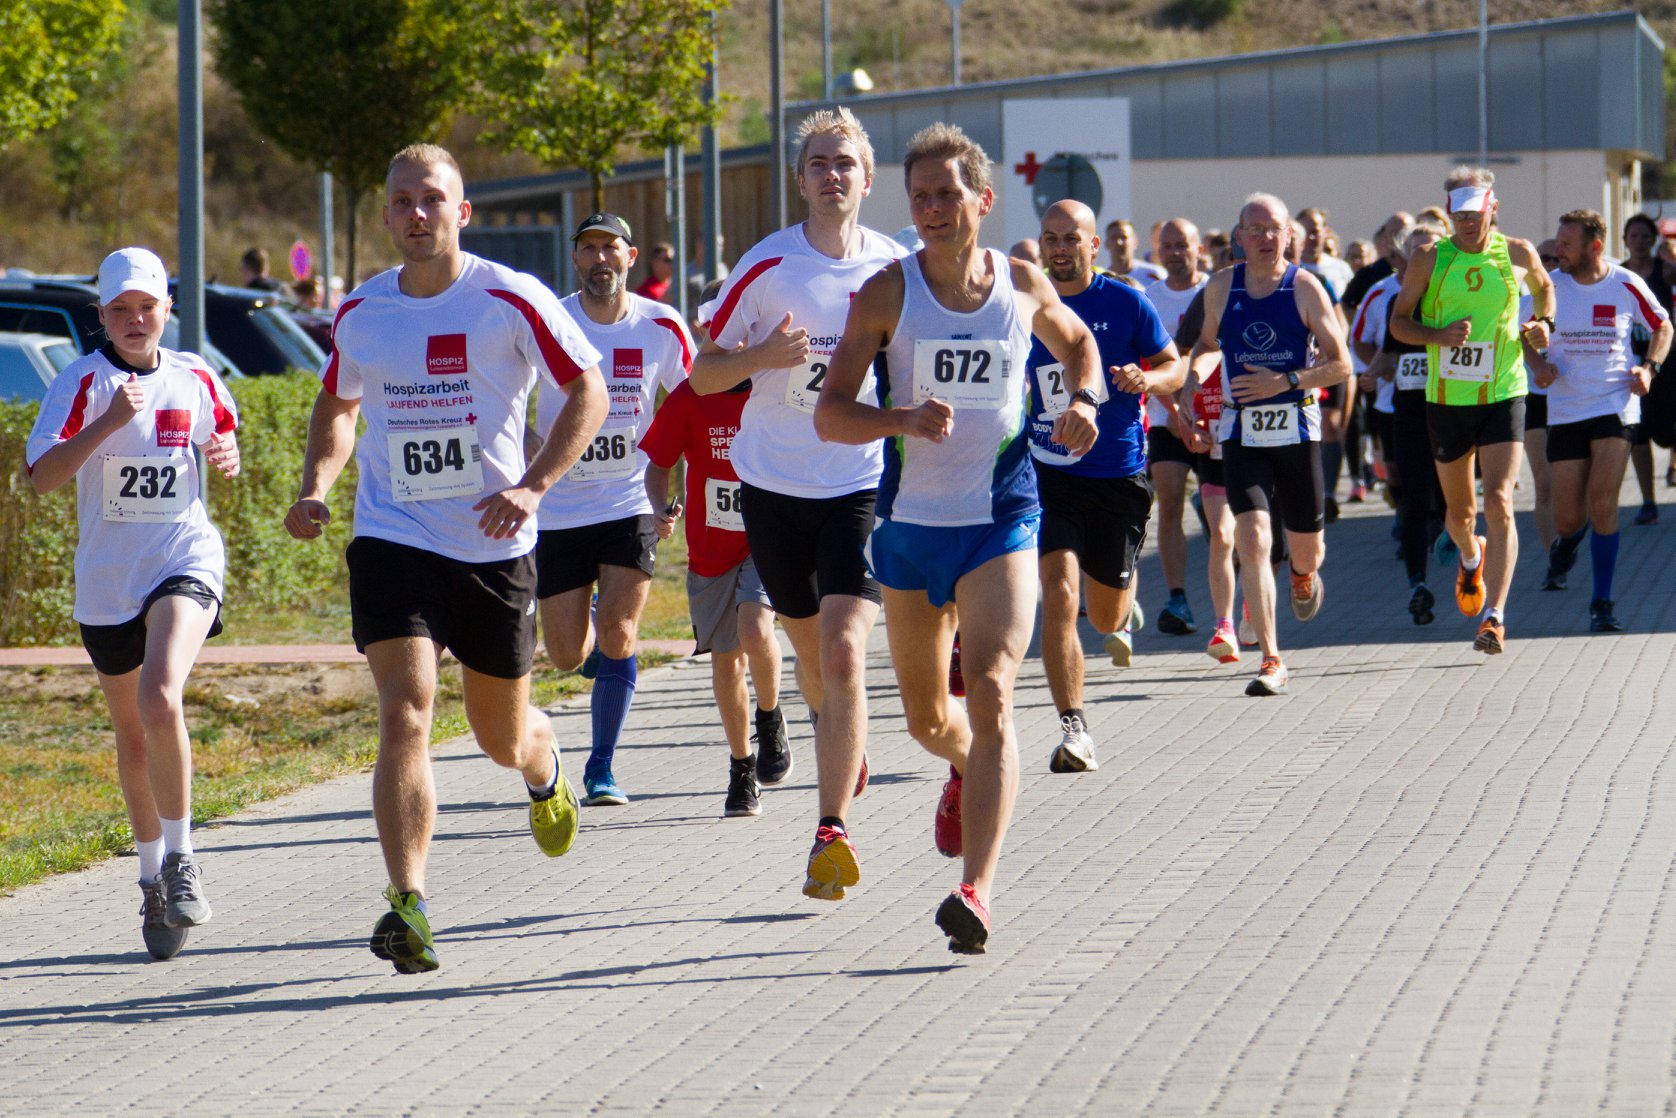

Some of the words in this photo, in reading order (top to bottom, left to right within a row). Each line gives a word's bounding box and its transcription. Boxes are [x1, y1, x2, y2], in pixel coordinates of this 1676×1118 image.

[806, 333, 842, 348] ospi
[429, 357, 464, 366] HOSPIZ
[1450, 346, 1483, 367] 287
[934, 349, 991, 383] 672
[1402, 359, 1428, 376] 525
[384, 380, 470, 397] Hospizarbeit
[607, 384, 641, 393] zarbeit
[1048, 370, 1064, 396] 2
[386, 399, 428, 409] LAUFEND
[431, 396, 473, 407] HELFEN
[388, 418, 418, 426] Deutsches
[1251, 410, 1288, 431] 322
[160, 431, 189, 439] HOSPIZ
[709, 427, 725, 436] DIE
[403, 438, 465, 475] 634
[120, 466, 176, 498] 232
